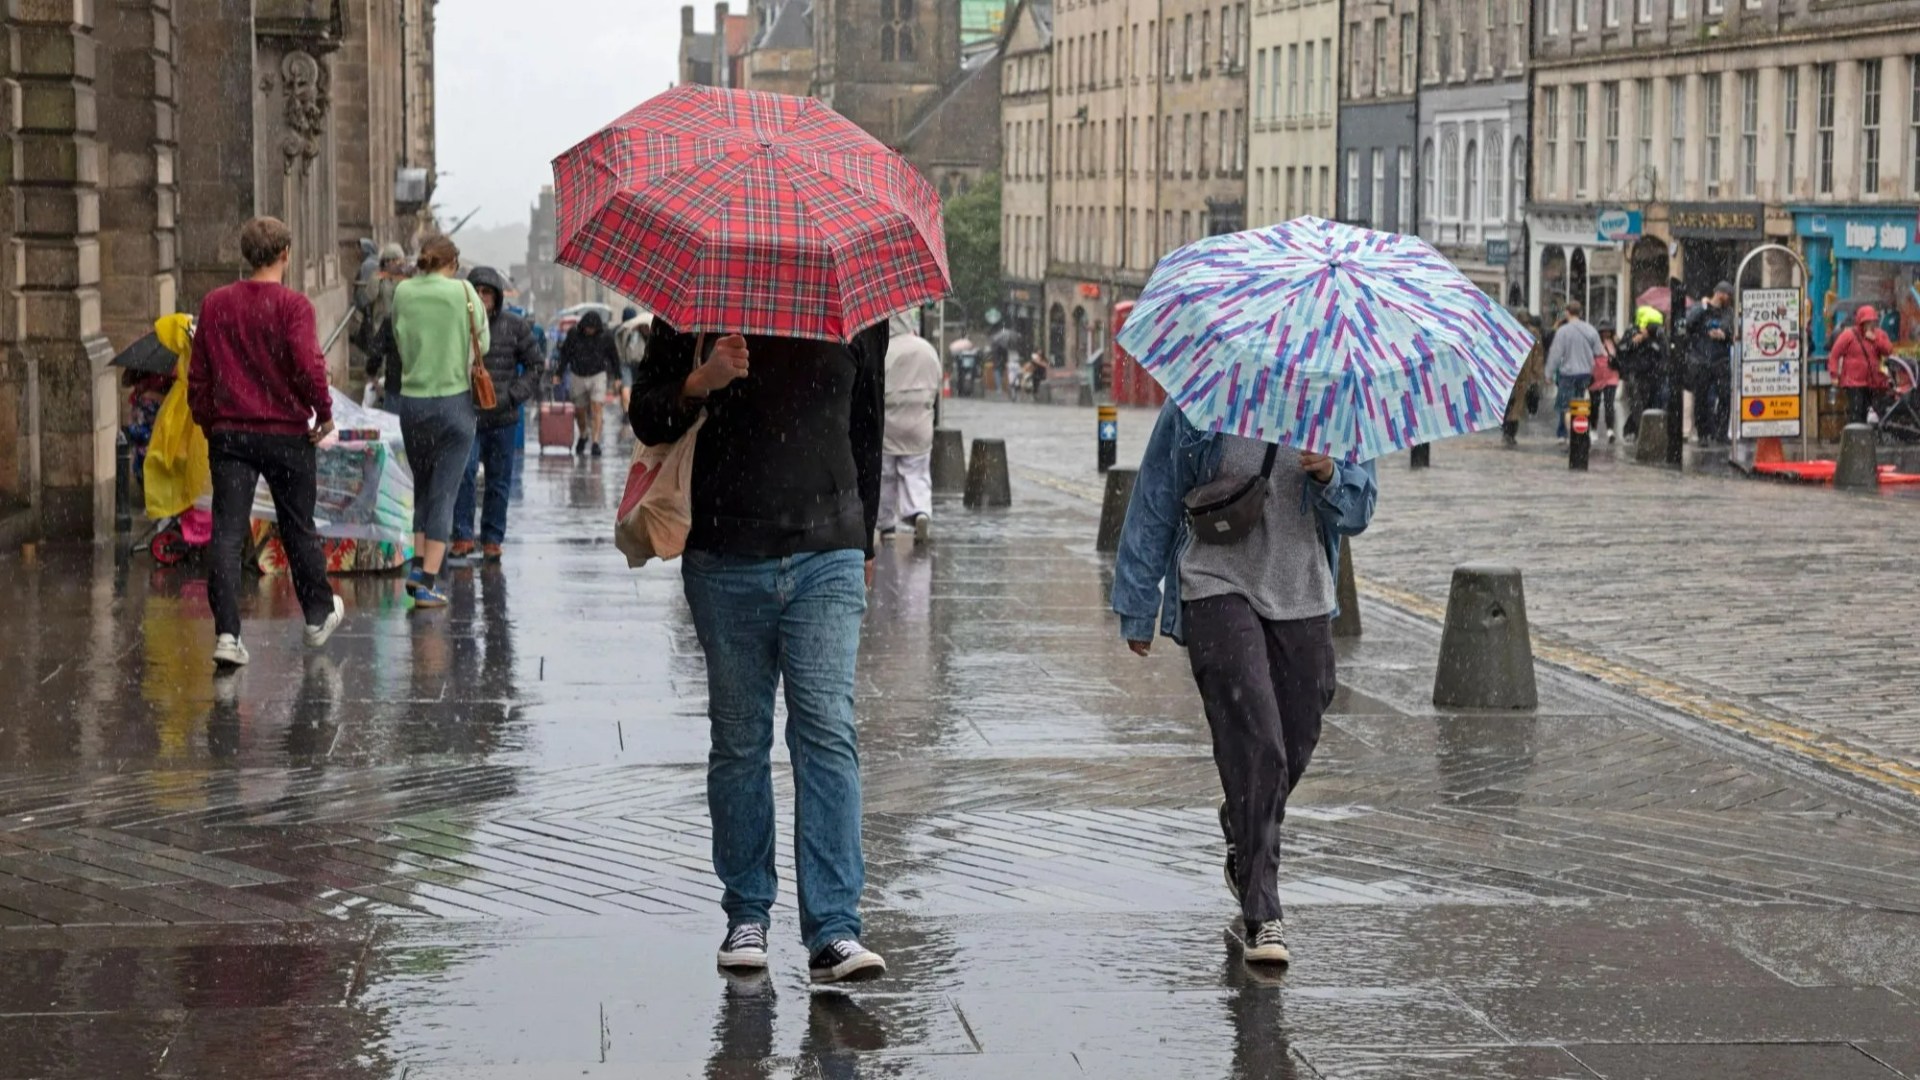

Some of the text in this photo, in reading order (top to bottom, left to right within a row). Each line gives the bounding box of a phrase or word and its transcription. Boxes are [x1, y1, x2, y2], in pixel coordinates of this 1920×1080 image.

[1846, 220, 1876, 252] fringe
[1880, 221, 1907, 252] shop
[1744, 292, 1796, 300] EDESTRIAN
[1765, 376, 1791, 384] loading
